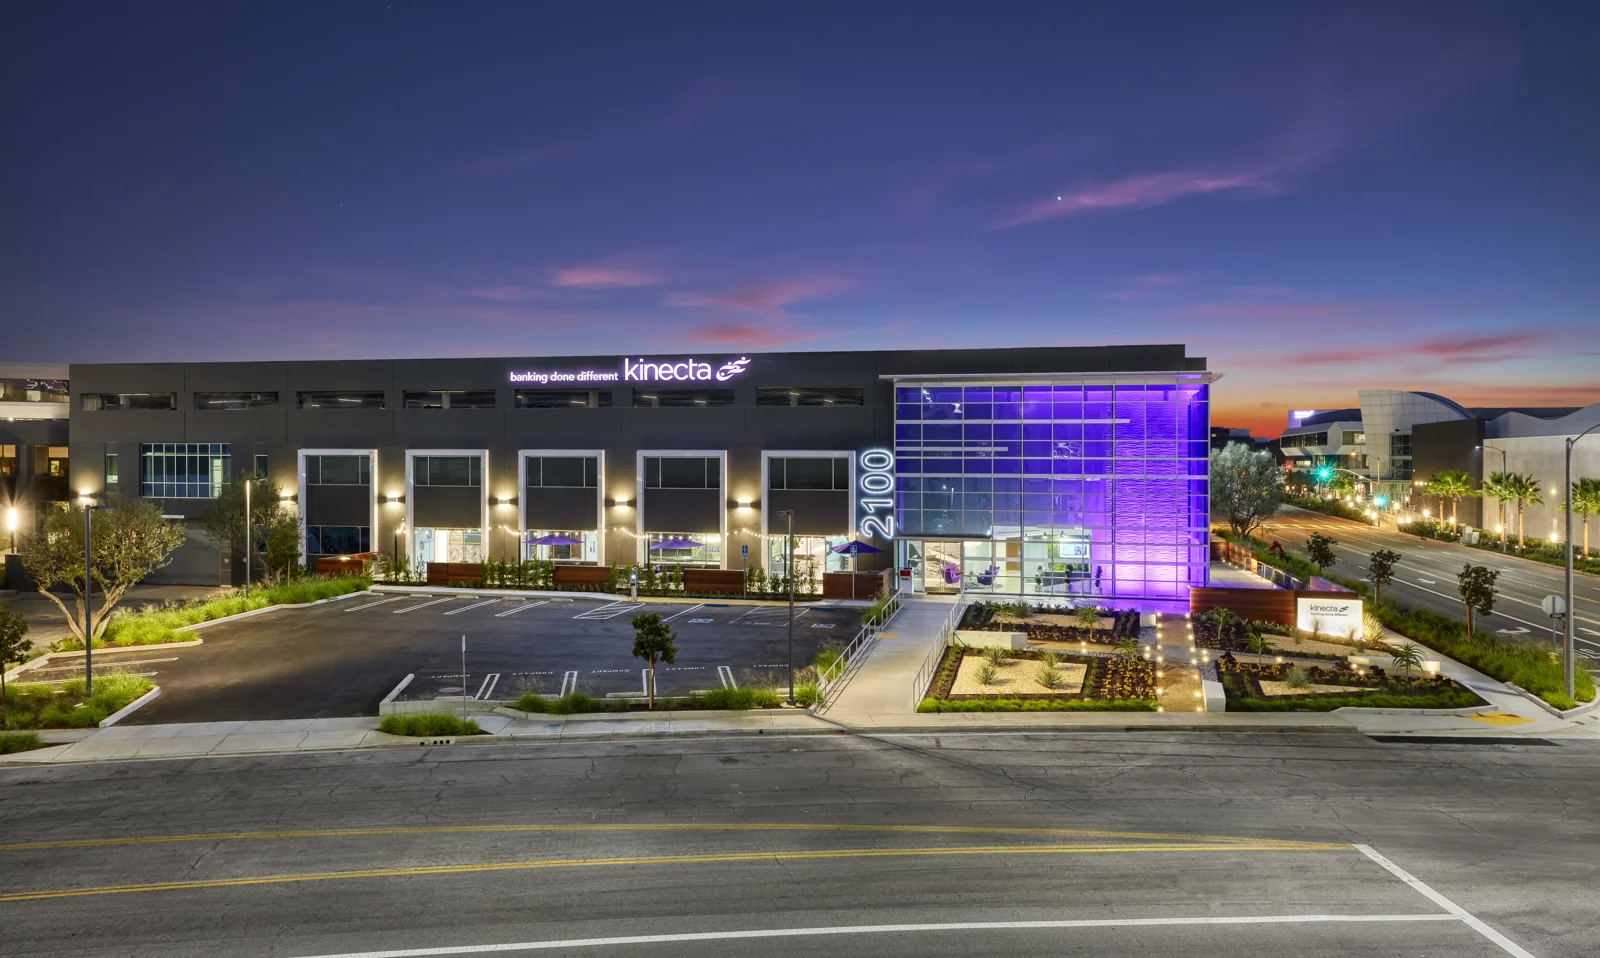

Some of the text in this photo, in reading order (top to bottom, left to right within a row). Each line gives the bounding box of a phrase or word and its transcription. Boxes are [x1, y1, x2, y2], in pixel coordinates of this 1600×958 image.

[510, 371, 619, 384] banking done different
[624, 358, 712, 381] kinecta
[861, 450, 893, 539] 2100
[1310, 604, 1338, 612] kinecta
